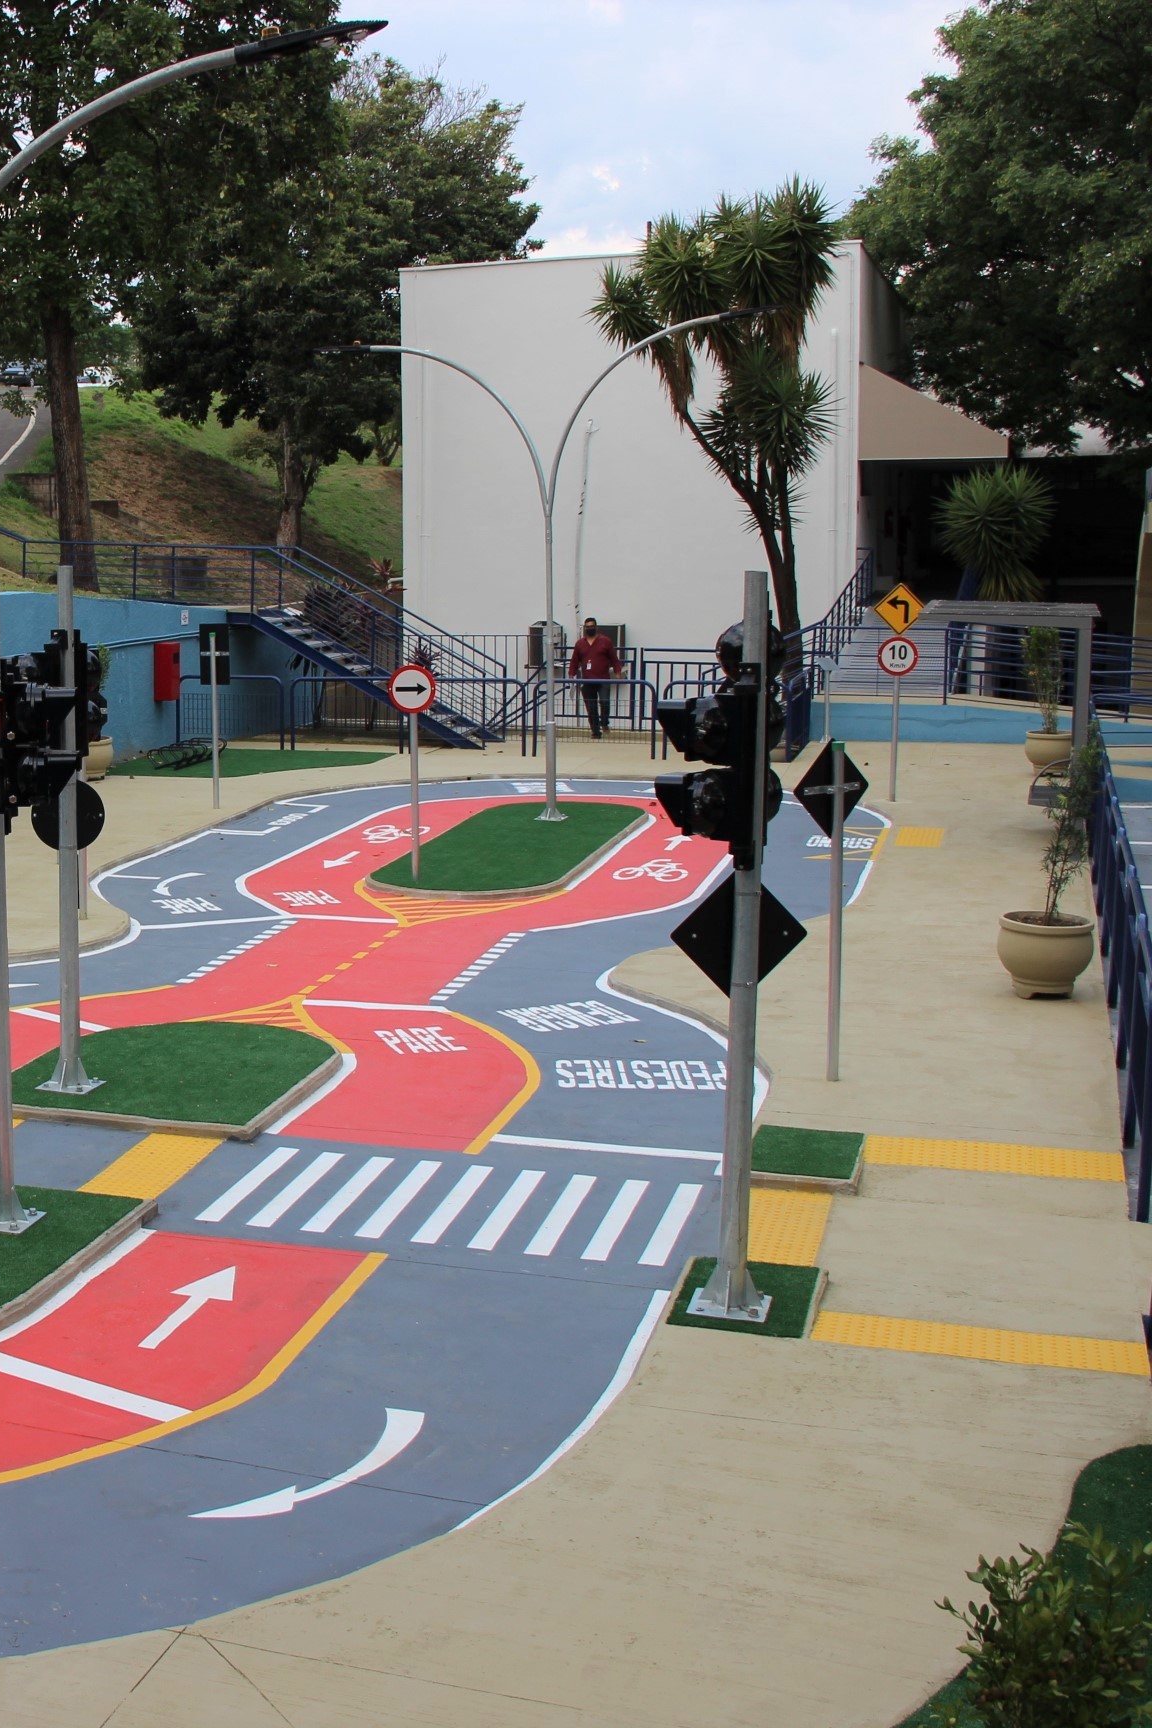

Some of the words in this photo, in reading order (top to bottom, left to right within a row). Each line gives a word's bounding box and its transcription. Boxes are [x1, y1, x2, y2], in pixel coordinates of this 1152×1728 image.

[888, 644, 908, 660] 10
[152, 897, 223, 915] PARE
[273, 890, 342, 907] PARE
[496, 1000, 640, 1032] DEVAGAR
[373, 1026, 468, 1055] PARE
[555, 1059, 727, 1090] PEDESTRES
